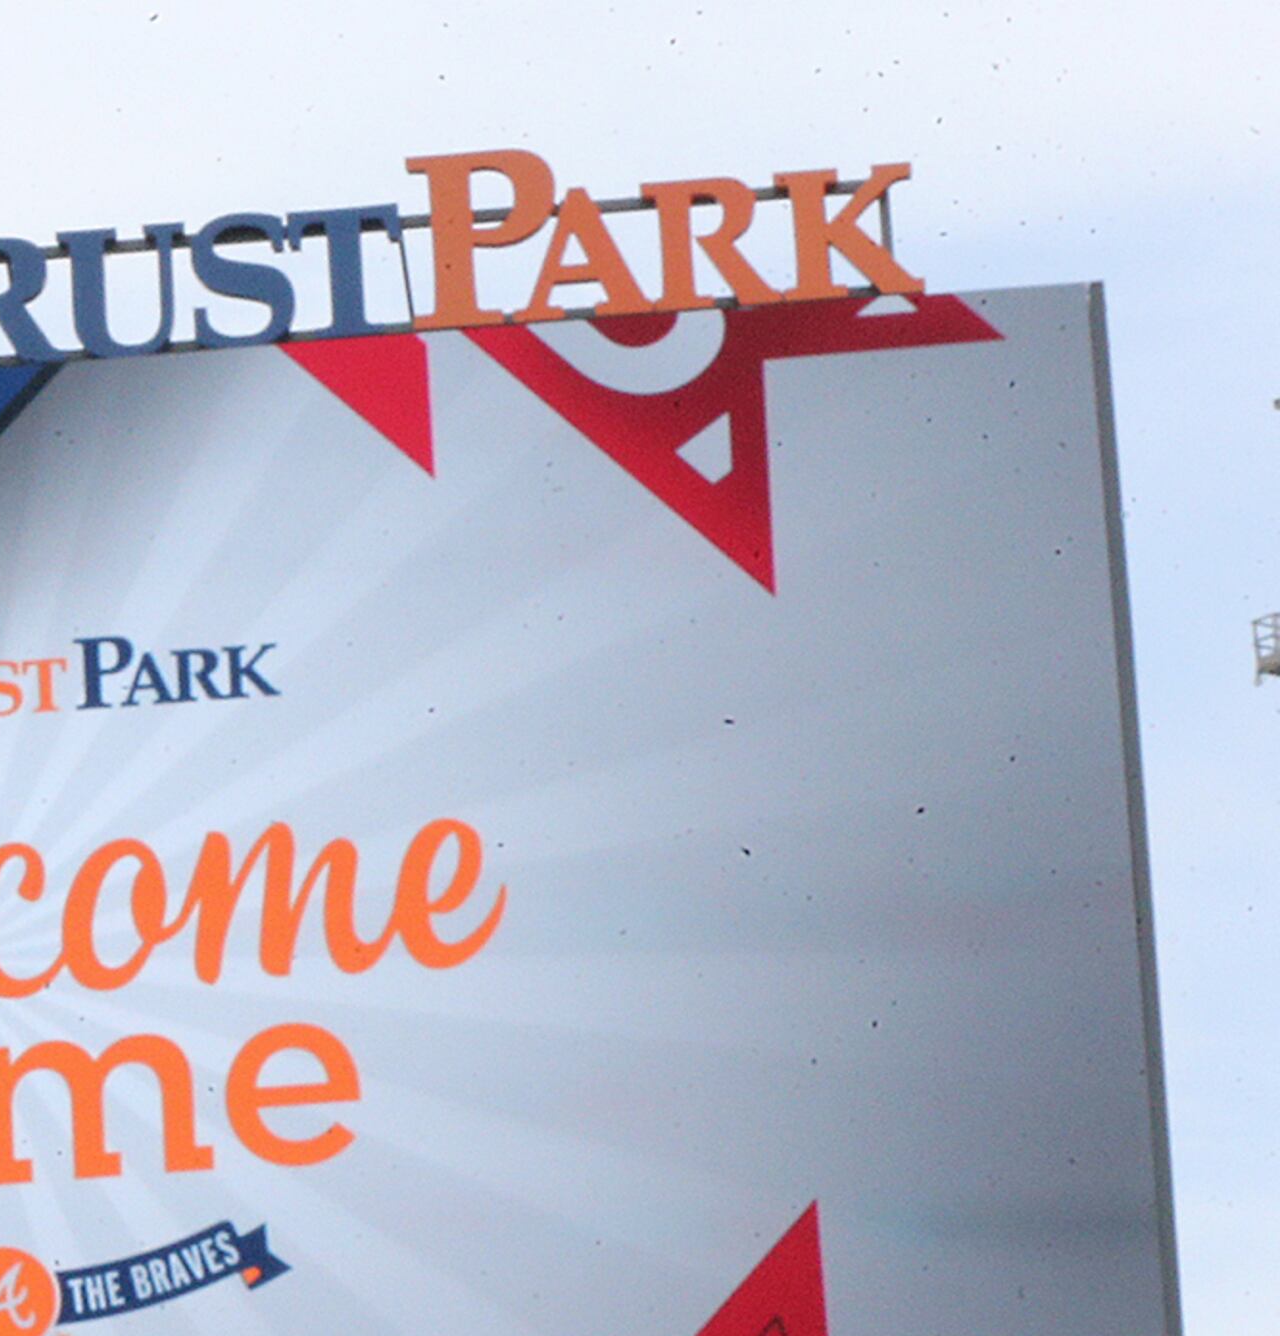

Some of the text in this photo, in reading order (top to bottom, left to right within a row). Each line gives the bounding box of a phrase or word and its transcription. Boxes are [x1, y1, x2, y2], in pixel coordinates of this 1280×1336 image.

[405, 148, 924, 331] PARK
[73, 635, 282, 712] PARK
[67, 1273, 123, 1315] THE
[134, 1229, 242, 1302] BRAVES
